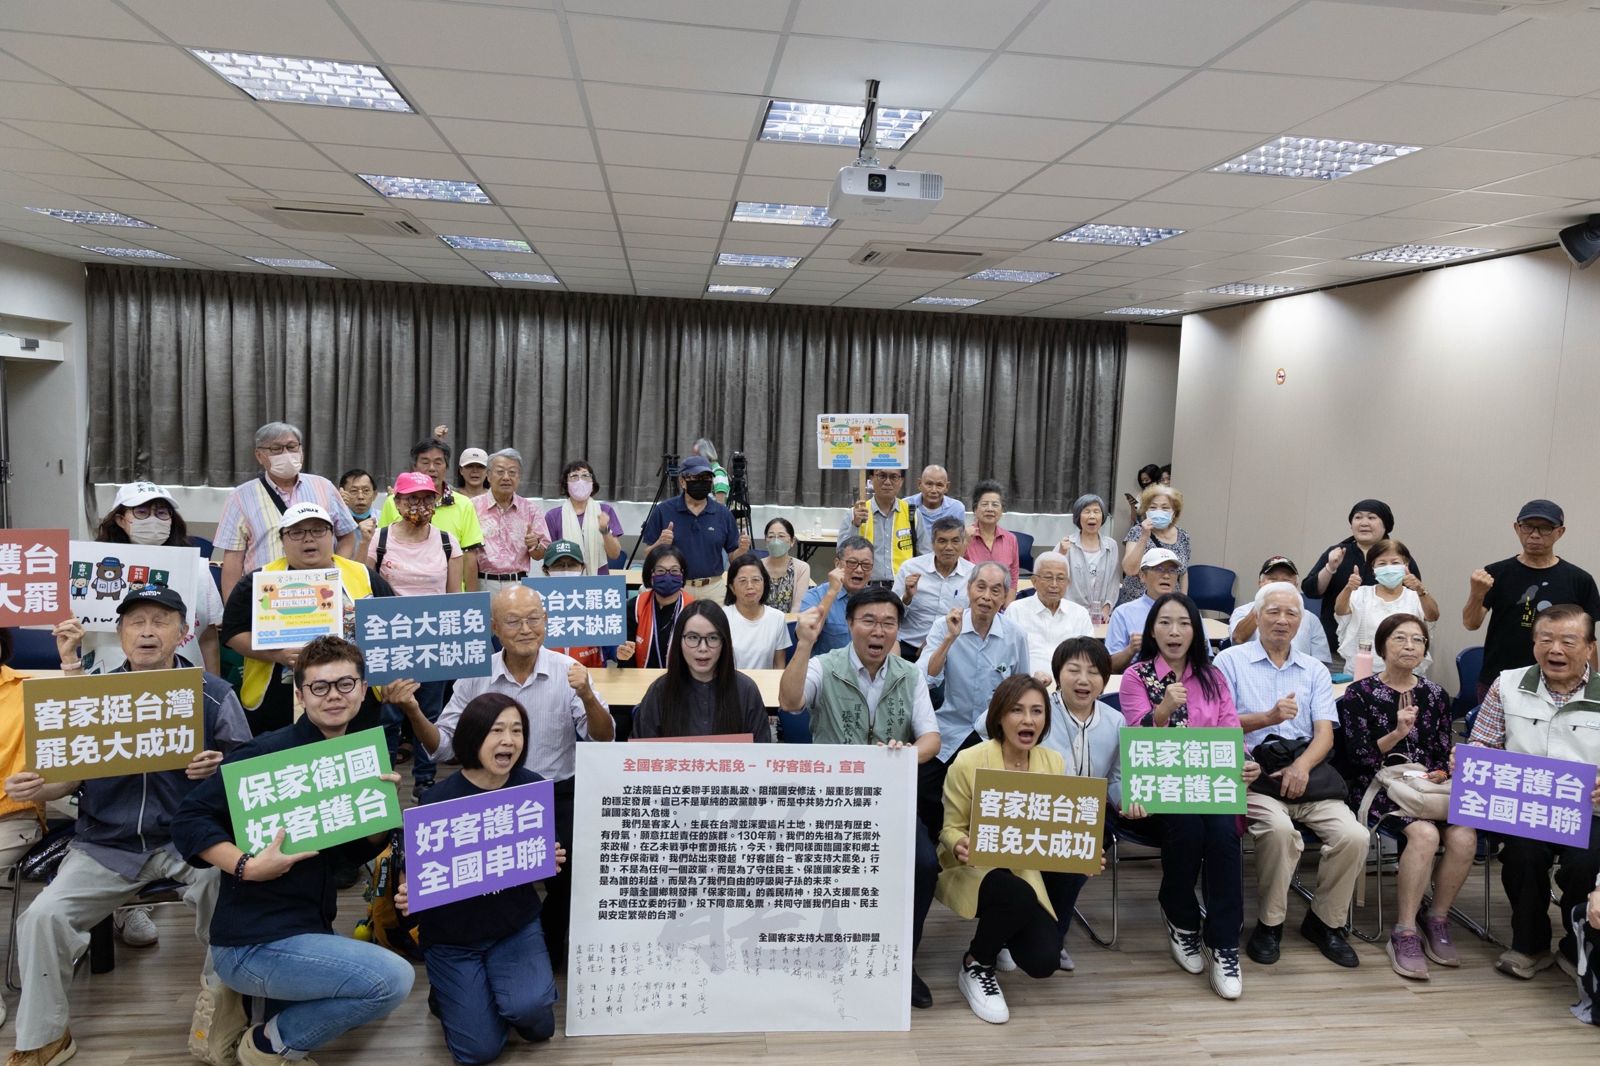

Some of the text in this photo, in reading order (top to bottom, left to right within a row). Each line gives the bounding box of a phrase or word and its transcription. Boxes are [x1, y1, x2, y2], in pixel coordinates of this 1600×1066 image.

[364, 609, 486, 641] 全台大罷免
[544, 614, 623, 638] 家不缺席
[365, 639, 487, 674] 客家不缺席
[34, 688, 196, 732] 客家挺台灣
[897, 697, 905, 726] 台北市
[35, 725, 195, 770] 罷免大成功
[1128, 740, 1237, 768] 保家衛國
[238, 745, 381, 811] 保家衛國
[1129, 774, 1238, 803] 好客護台
[1461, 757, 1586, 803] 好客護台
[246, 787, 388, 855] 好客護台
[979, 788, 1099, 825] 客家挺台灣
[1458, 790, 1583, 836] 全國串聯
[415, 800, 545, 856] 好客護台
[975, 824, 1096, 860] 罷免大成功
[417, 835, 547, 896] 全國串聯
[758, 933, 881, 943] 全國客家支持大罷免行動聯盟
